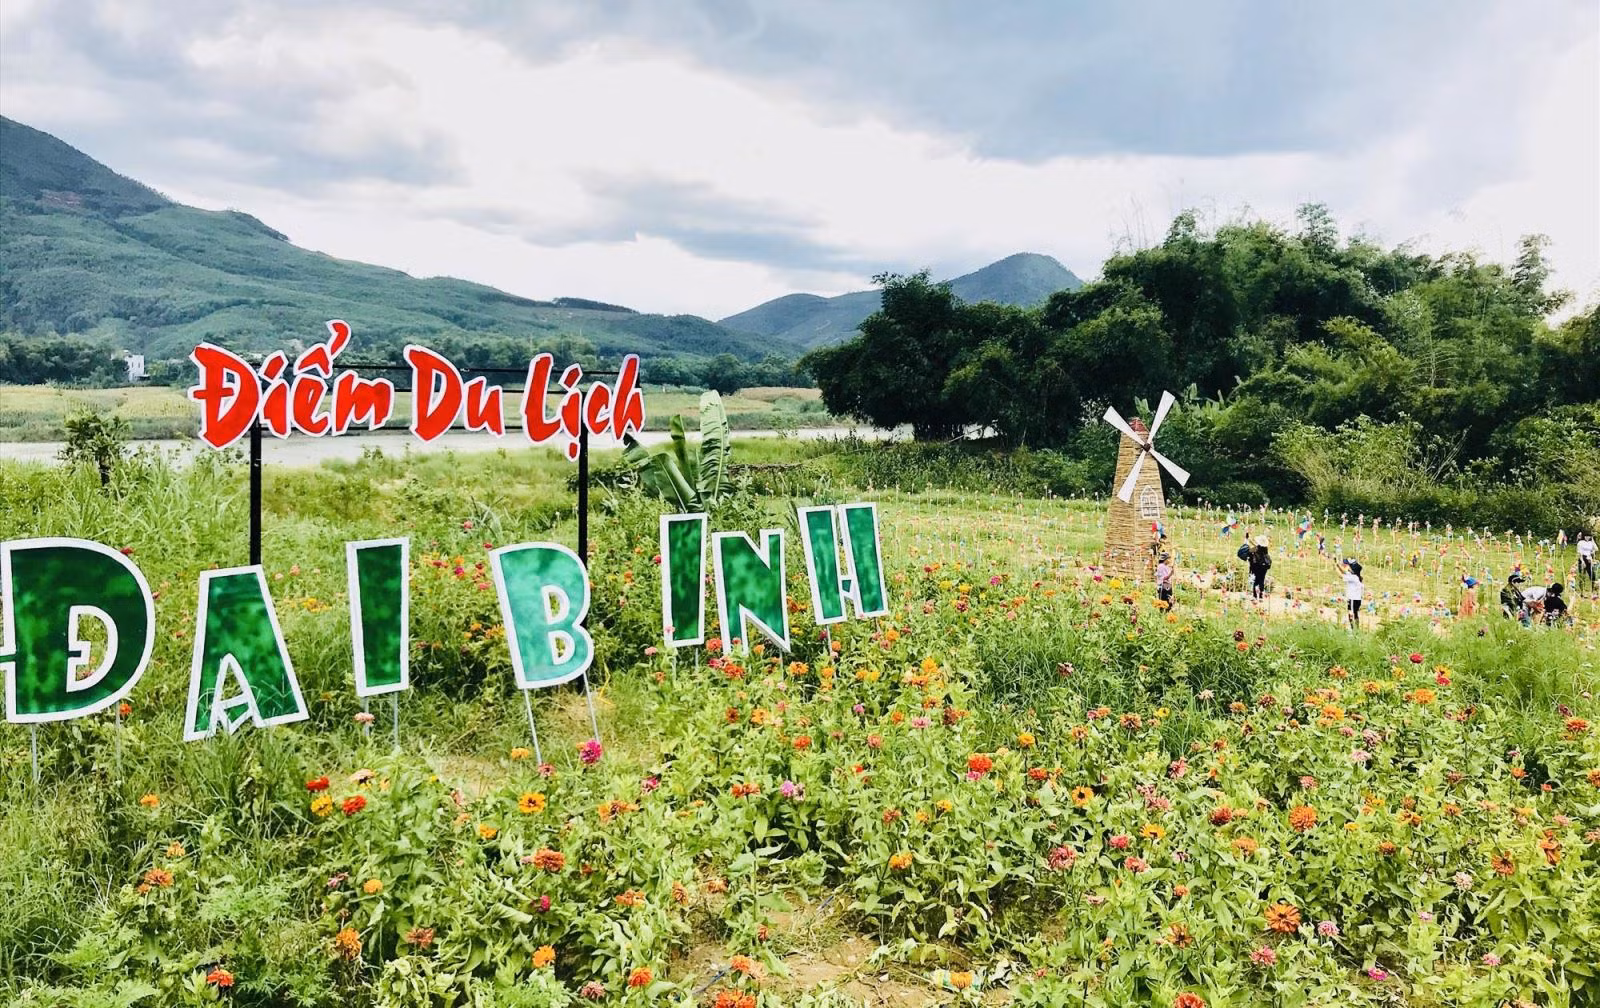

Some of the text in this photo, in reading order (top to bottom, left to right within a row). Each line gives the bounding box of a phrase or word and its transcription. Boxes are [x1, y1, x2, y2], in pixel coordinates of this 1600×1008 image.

[188, 319, 646, 462] Điểm Du Lịch
